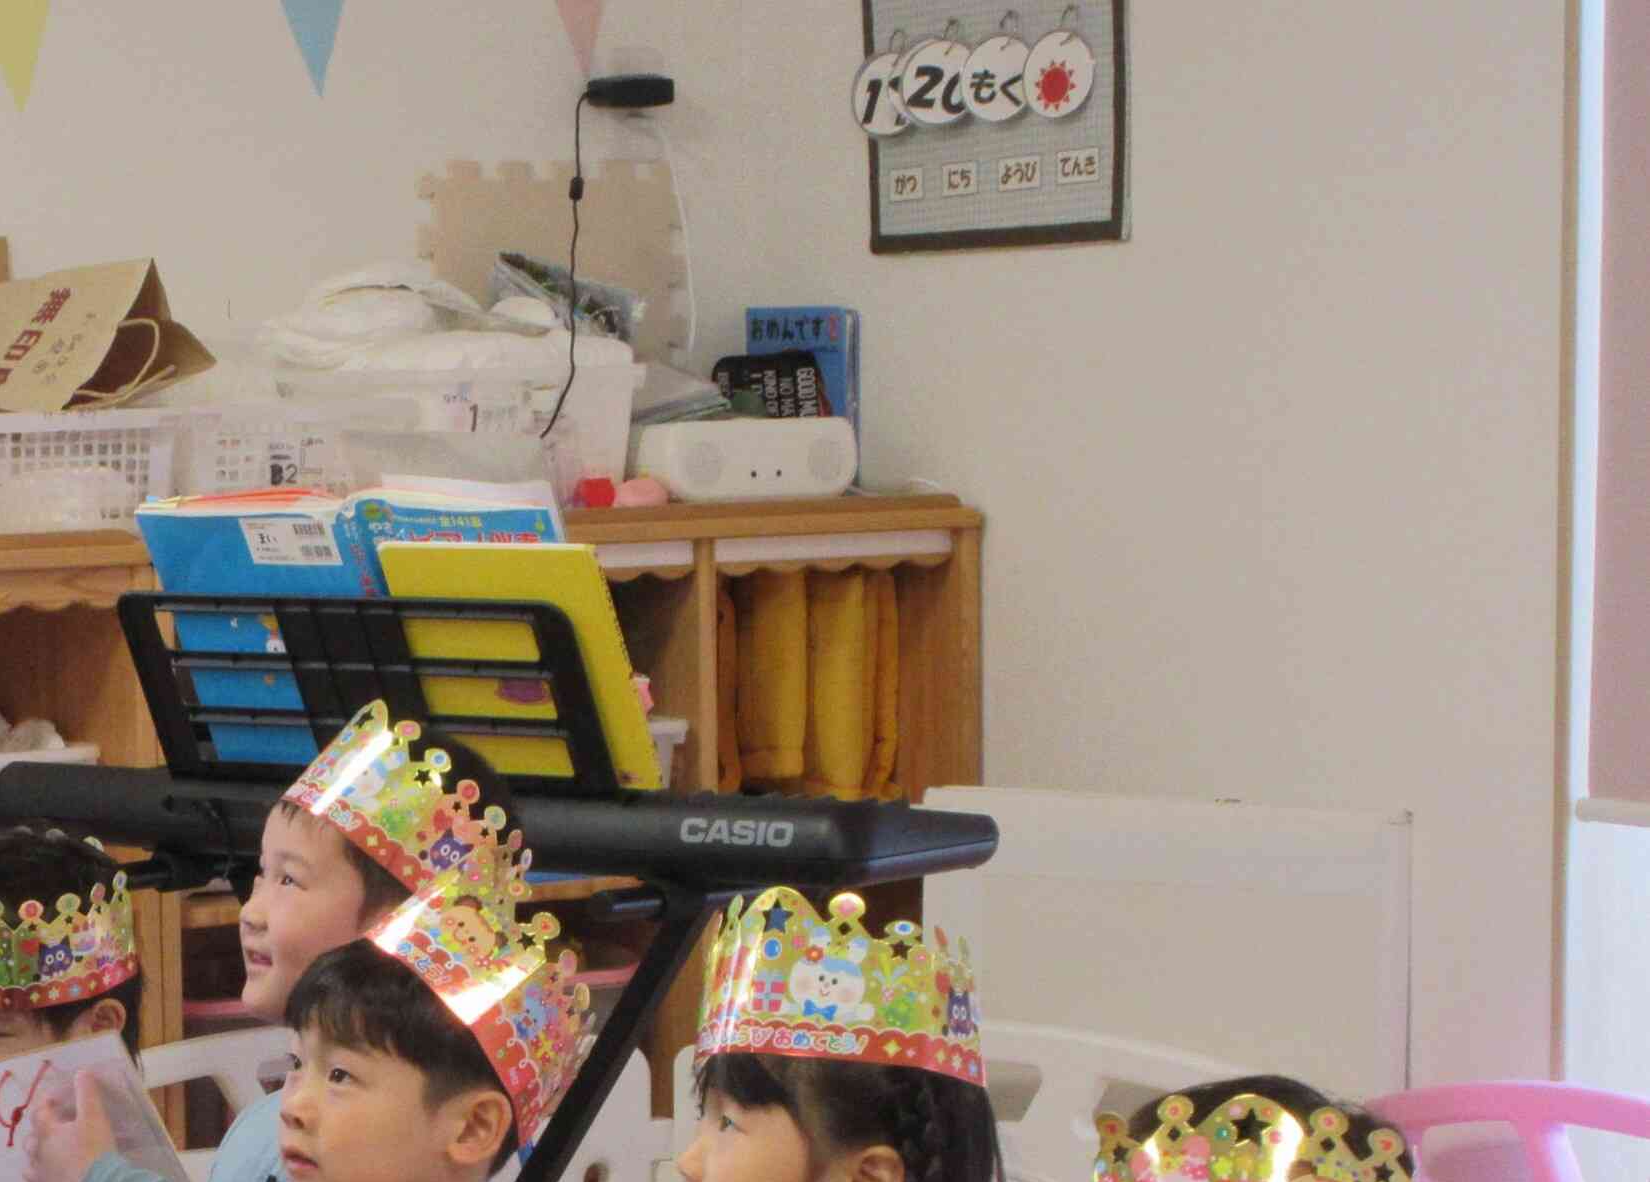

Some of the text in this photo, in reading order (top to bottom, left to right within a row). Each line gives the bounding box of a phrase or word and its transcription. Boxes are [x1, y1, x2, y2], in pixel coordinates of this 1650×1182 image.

[969, 68, 1023, 108] もく
[894, 154, 1097, 195] がつ にち ようび てんき
[680, 817, 794, 848] CASIO
